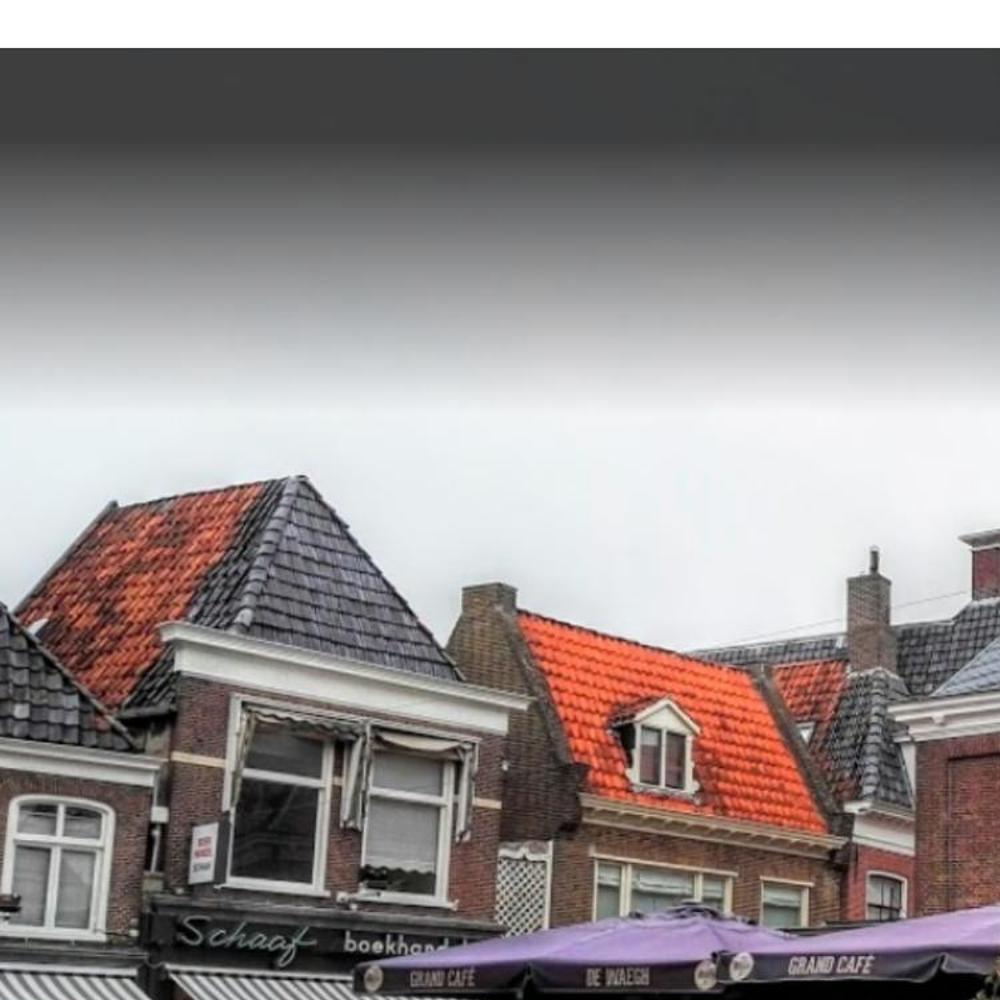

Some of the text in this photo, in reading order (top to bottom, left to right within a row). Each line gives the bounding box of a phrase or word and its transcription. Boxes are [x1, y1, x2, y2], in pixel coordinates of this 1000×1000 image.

[182, 915, 468, 967] Schaaf boekhand
[788, 953, 876, 975] GRAND CAFÉ
